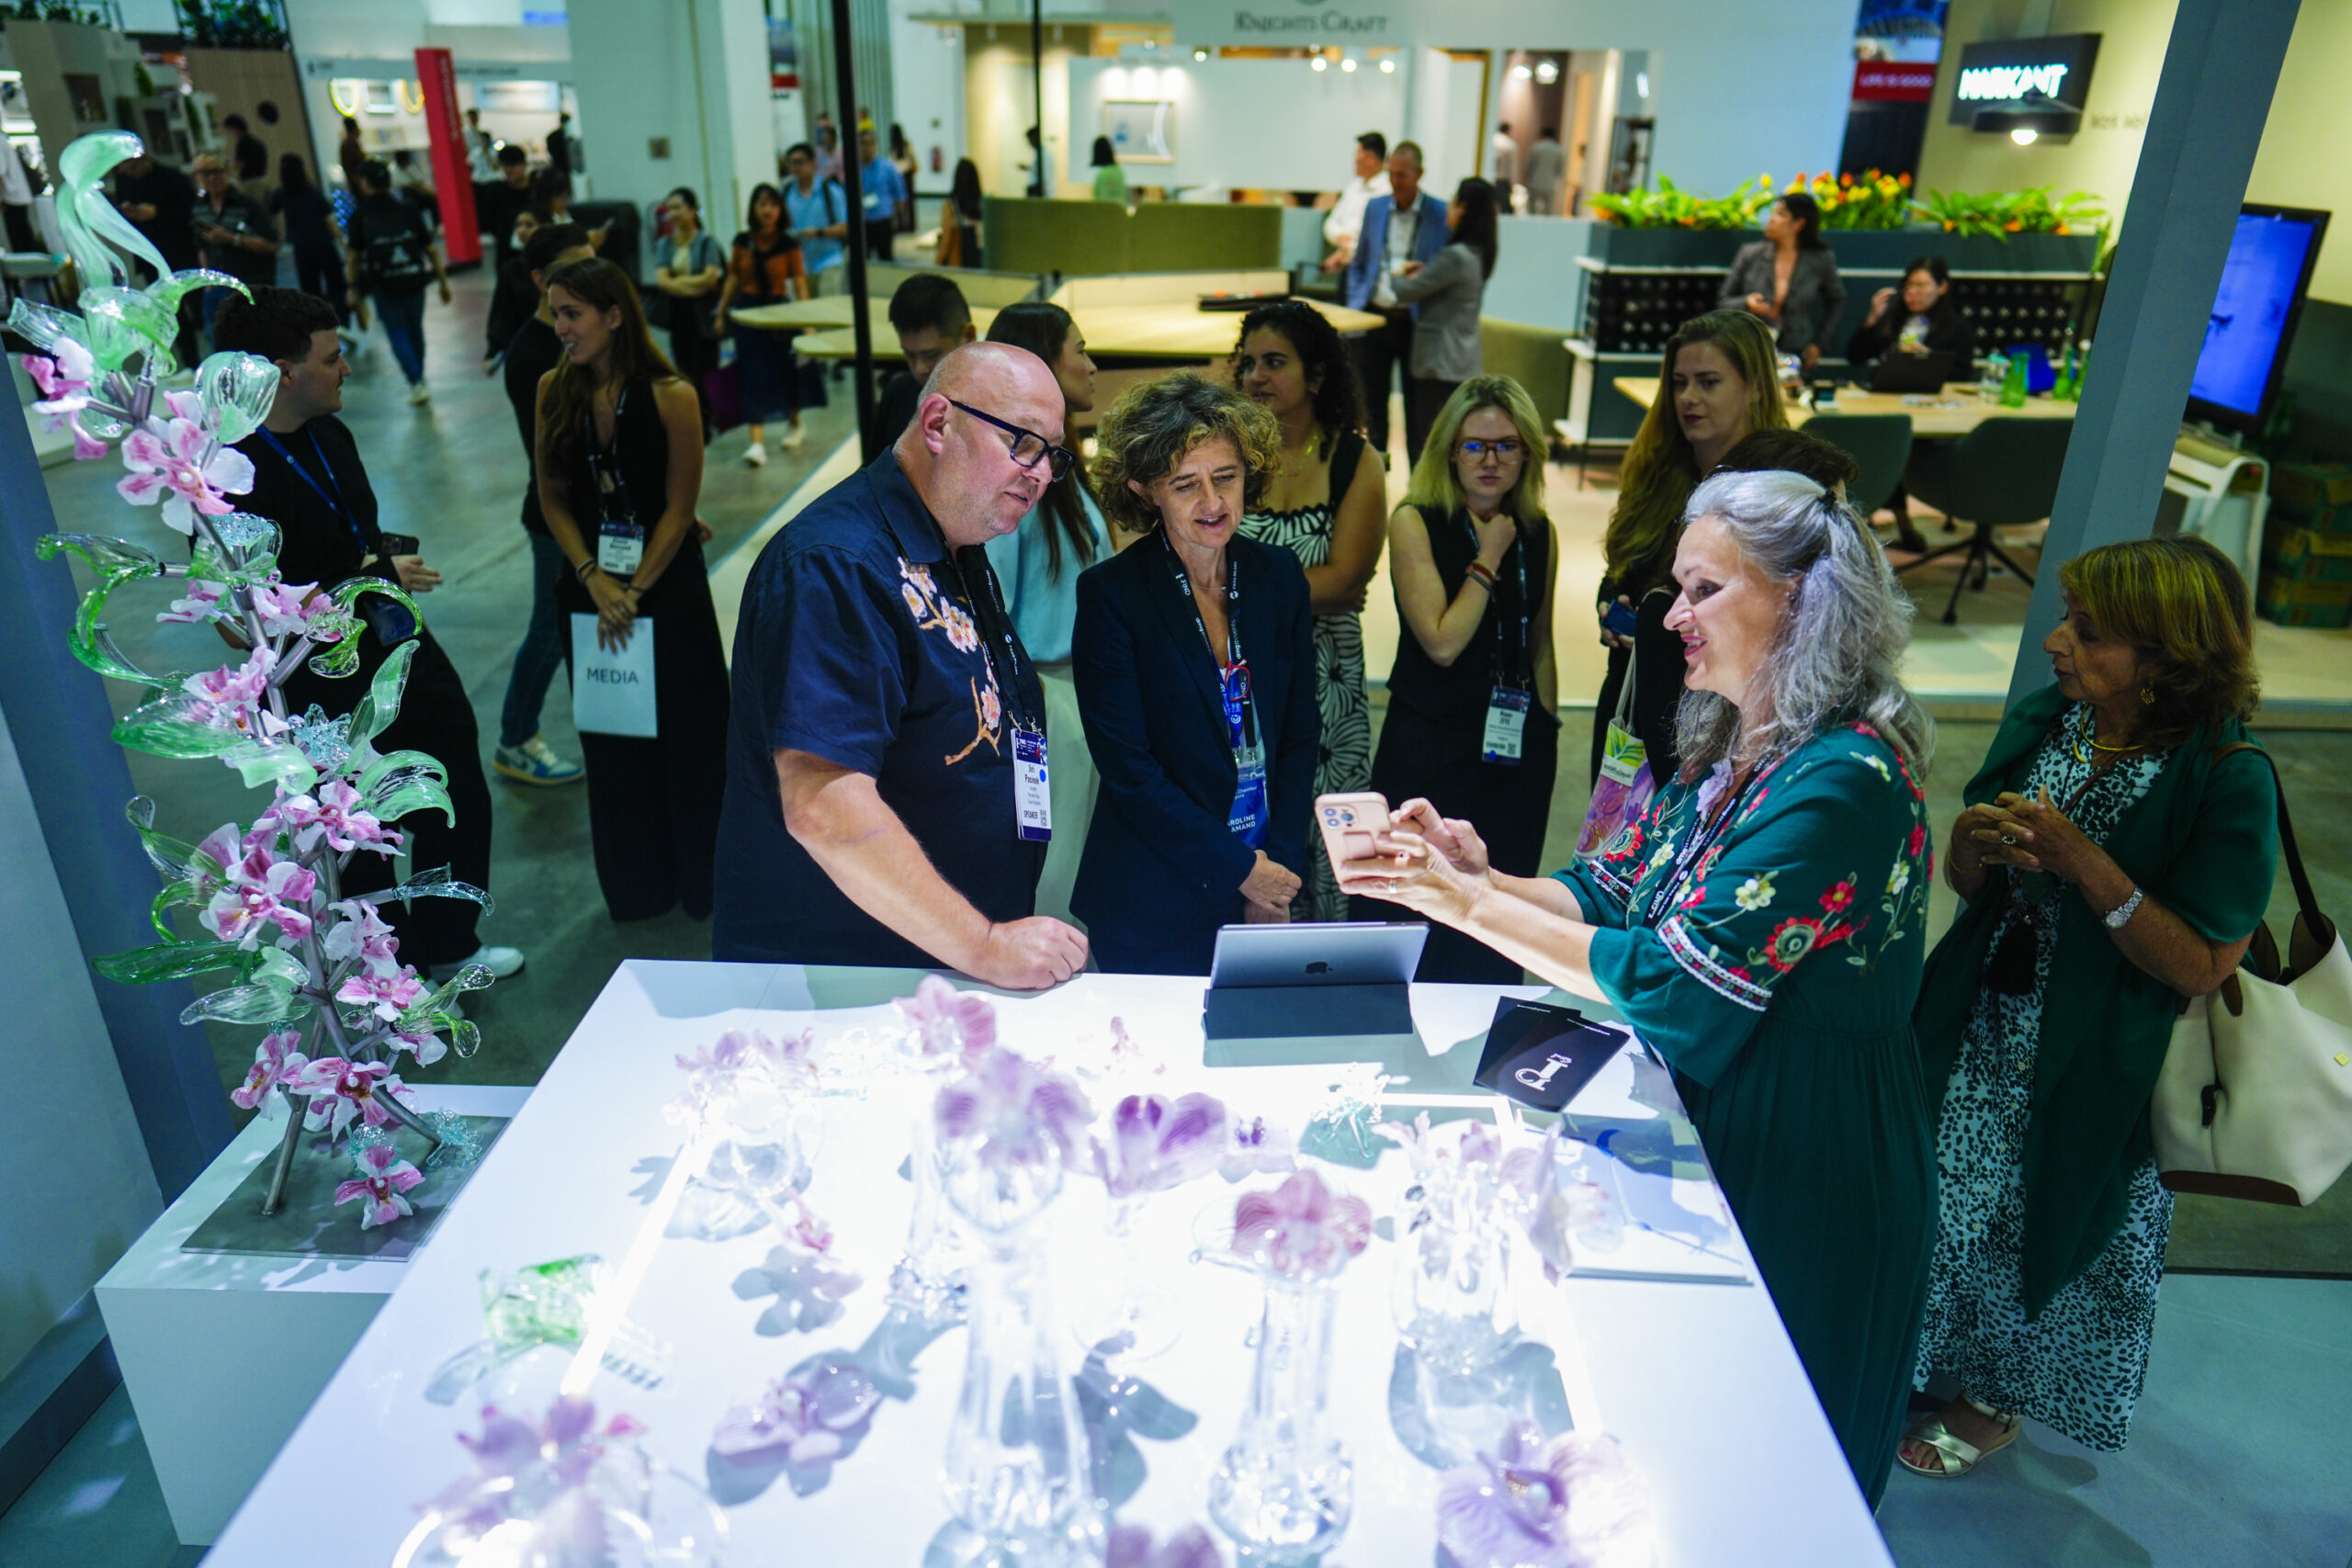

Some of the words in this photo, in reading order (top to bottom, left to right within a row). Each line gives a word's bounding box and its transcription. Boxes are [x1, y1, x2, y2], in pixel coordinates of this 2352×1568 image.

[1321, 10, 1388, 33] CRAFT
[1957, 63, 2068, 100] MARKANT
[587, 666, 639, 684] MEDIA
